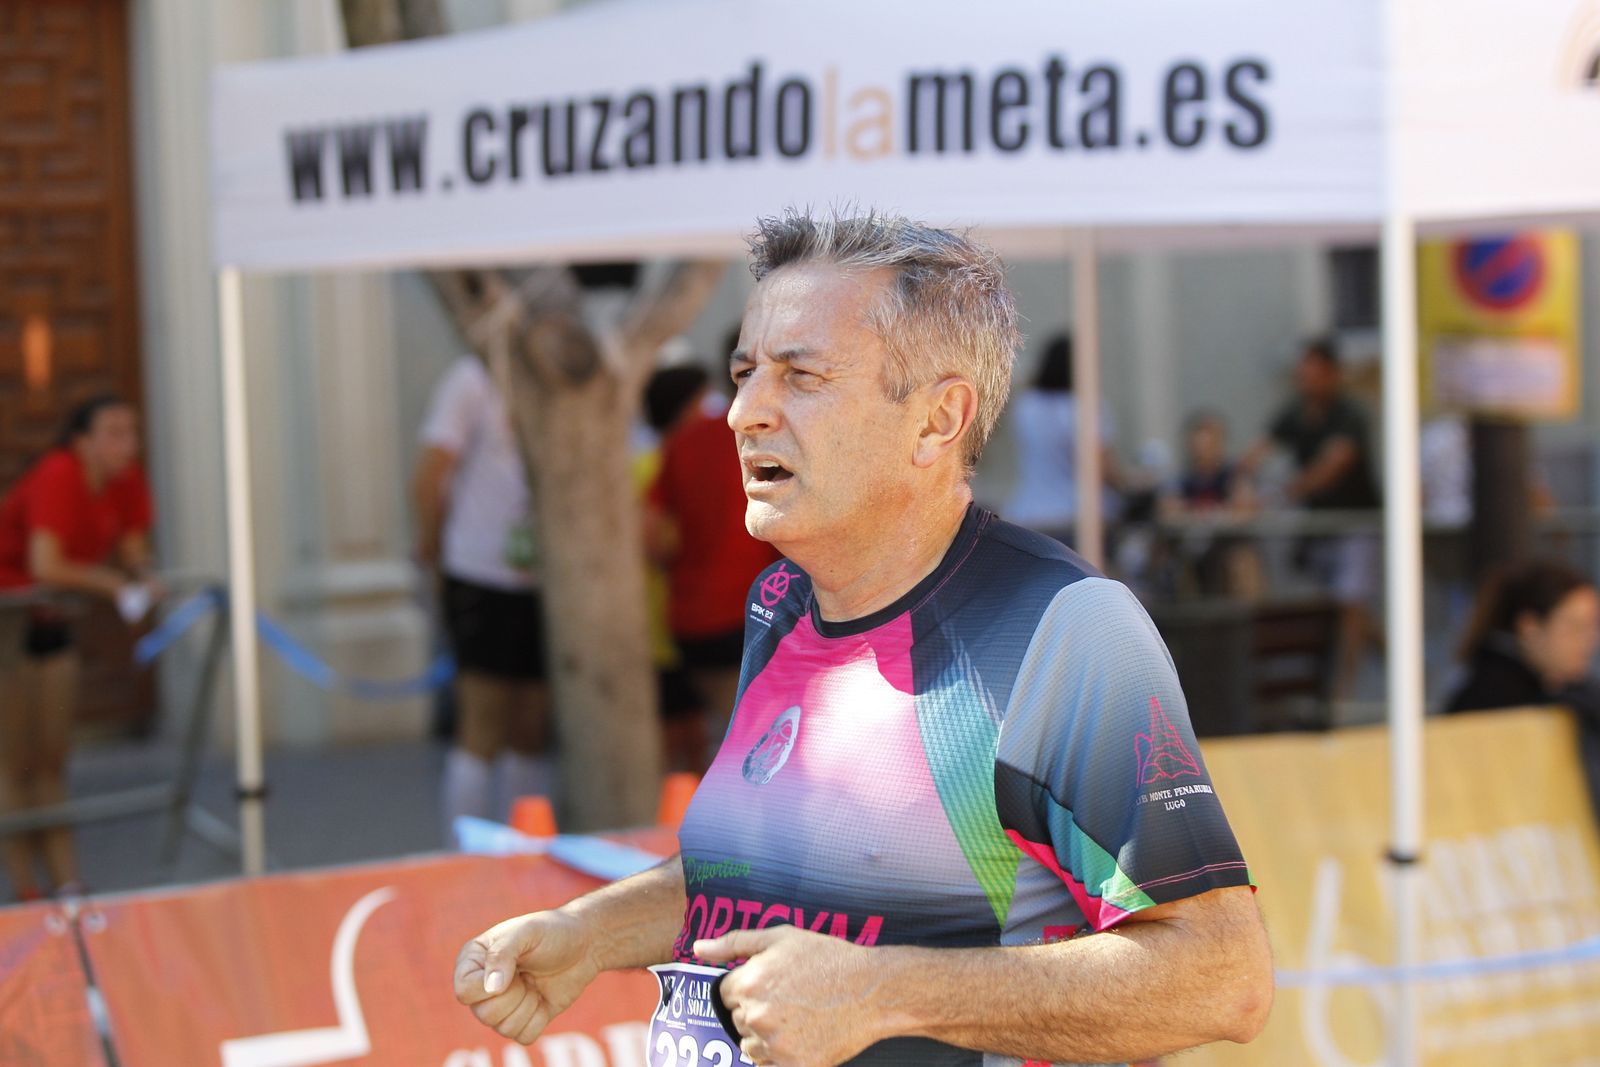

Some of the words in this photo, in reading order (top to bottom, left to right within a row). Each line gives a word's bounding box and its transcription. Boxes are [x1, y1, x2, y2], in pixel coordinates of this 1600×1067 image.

[284, 56, 1273, 204] www.cruzandolameta.es
[1149, 790, 1173, 802] MONTE
[1164, 799, 1186, 811] LUGO
